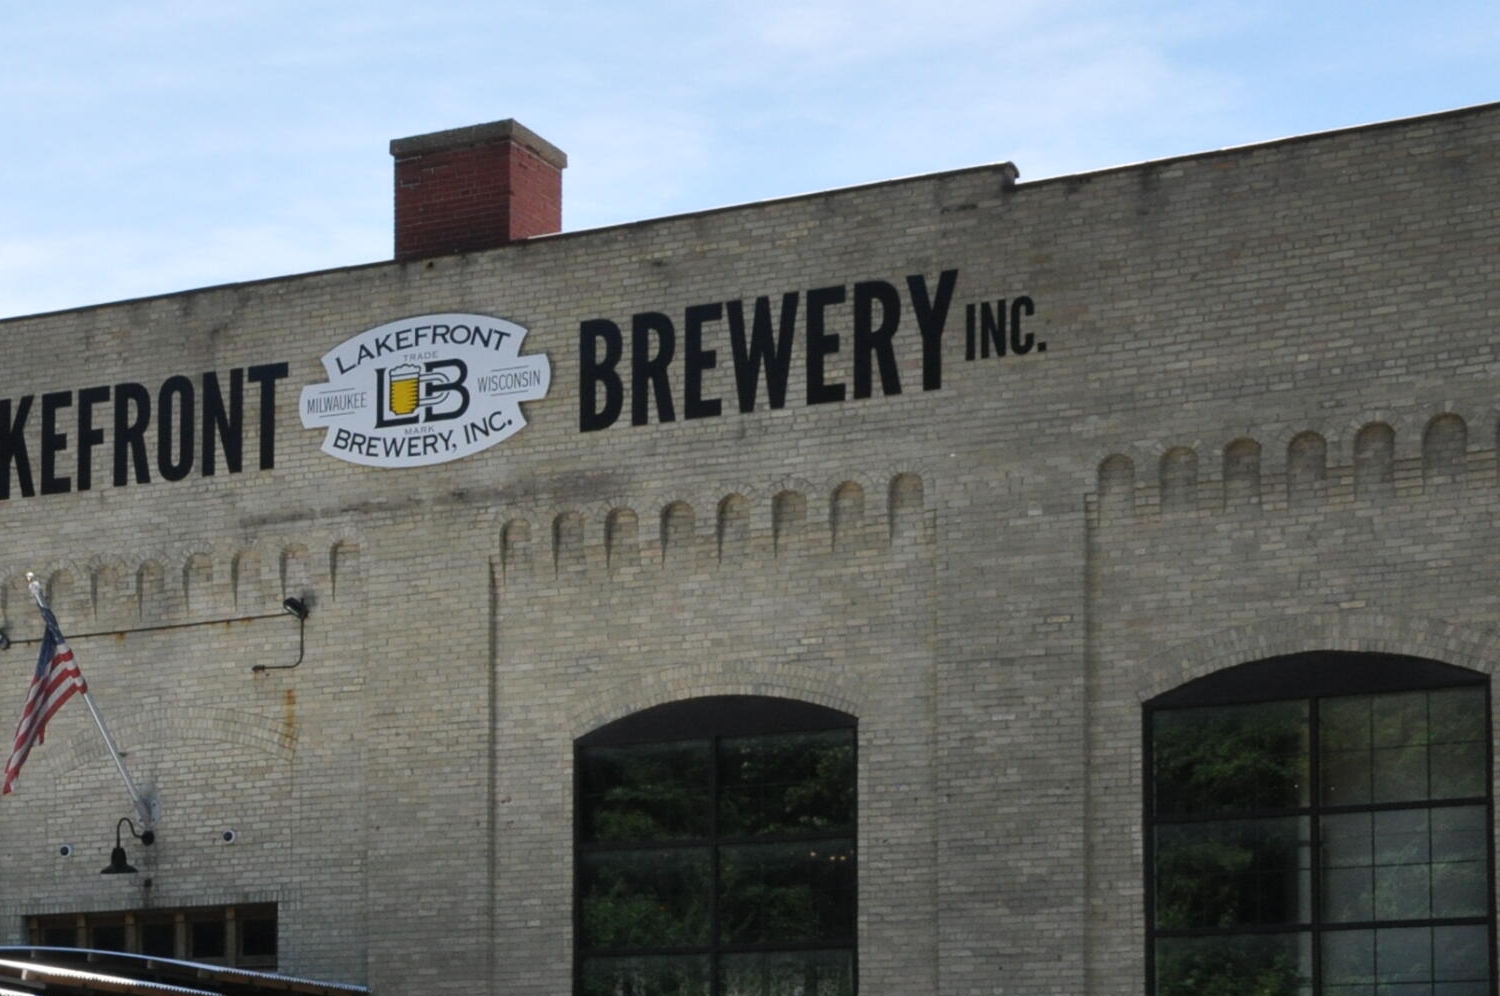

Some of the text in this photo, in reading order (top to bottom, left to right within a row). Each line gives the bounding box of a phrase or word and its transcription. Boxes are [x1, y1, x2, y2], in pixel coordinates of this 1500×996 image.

[335, 324, 511, 375] LAKEFRONT
[402, 350, 439, 362] TRADE
[580, 269, 959, 433] BREWERY
[965, 295, 1047, 361] INC.
[477, 369, 541, 393] WISCONSIN
[306, 391, 368, 415] MILWAUKEE
[333, 410, 513, 458] BREWERY, INC.
[404, 425, 435, 435] MARK
